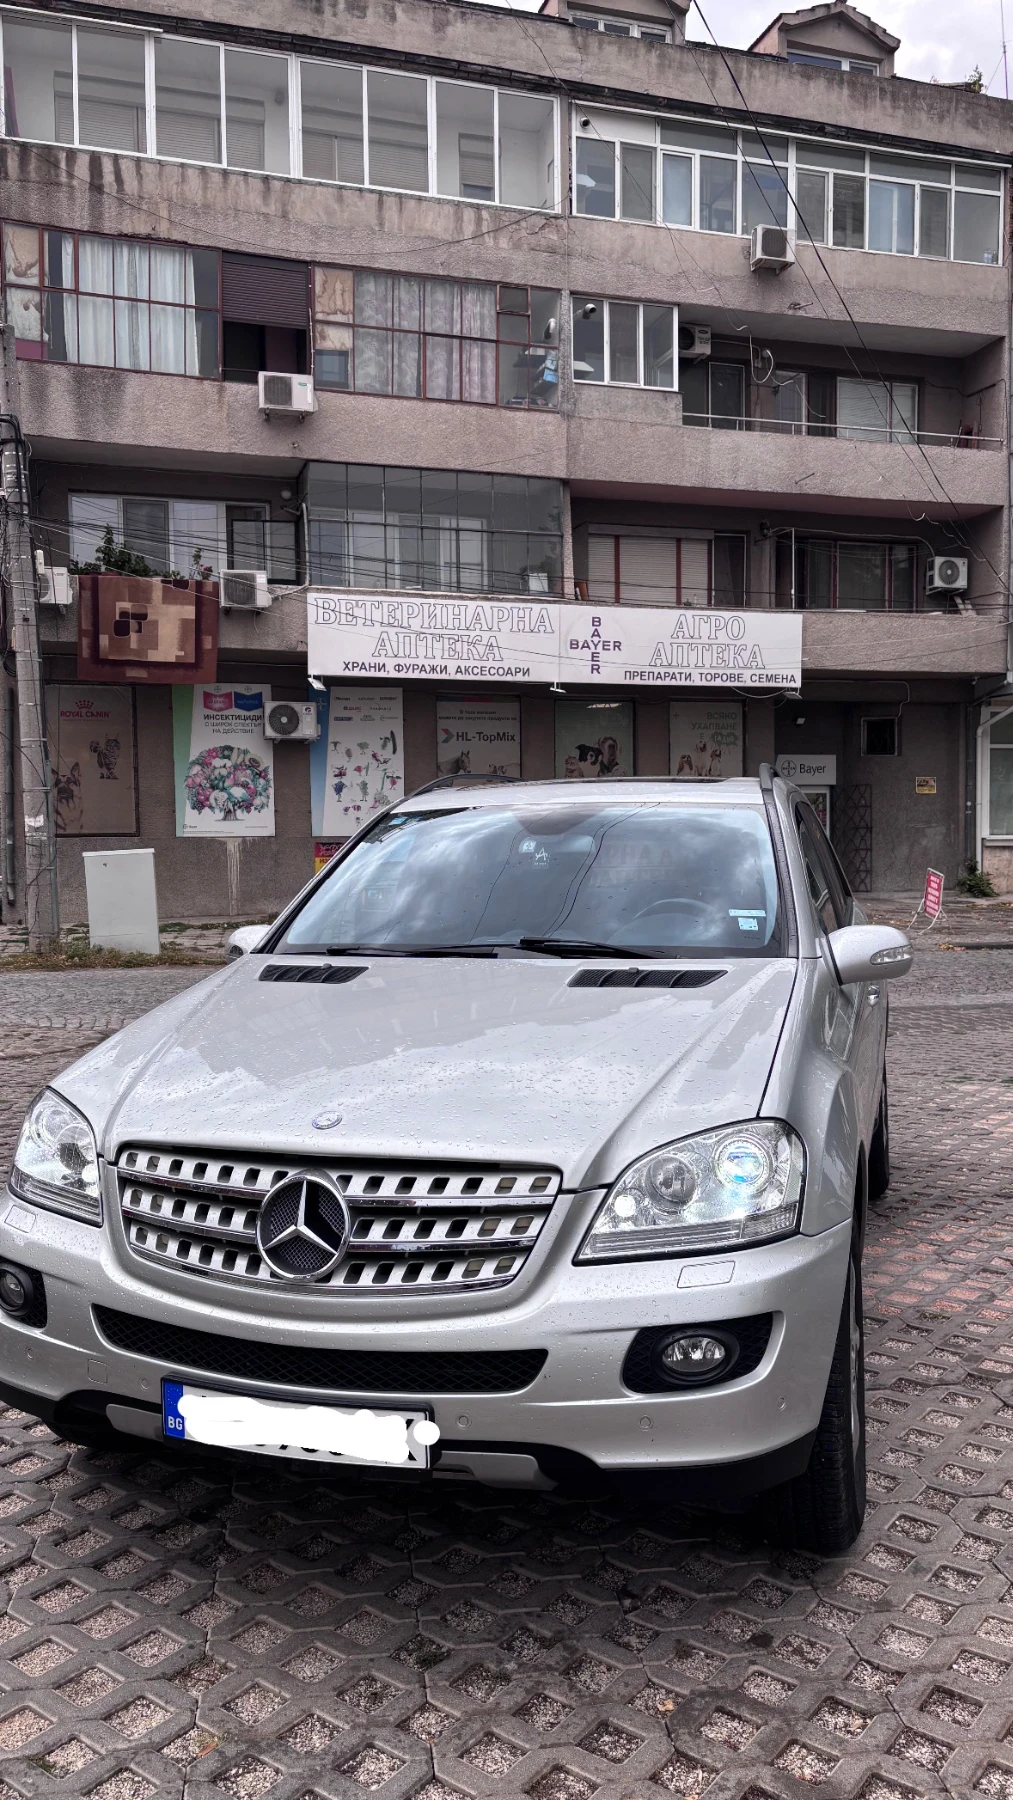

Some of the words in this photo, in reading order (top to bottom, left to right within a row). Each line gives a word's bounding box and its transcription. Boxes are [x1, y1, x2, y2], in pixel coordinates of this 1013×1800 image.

[315, 598, 554, 633] ВЕТЕРИНАРНА
[671, 614, 746, 640] АГРО
[372, 631, 503, 661] АПТЕКА
[569, 639, 622, 651] BAYER
[590, 616, 602, 675] BAYER
[650, 641, 765, 669] АПТЕКА
[343, 661, 390, 675] ХРАНИ,
[394, 663, 451, 676] ФУРАЖИ,
[455, 665, 530, 677] АКСЕСОАРИ
[624, 670, 695, 683] ПРЕПАРАТИ,
[698, 672, 746, 684] ТОРОВЕ,
[750, 673, 797, 684] СЕМЕНА
[60, 710, 84, 718] ROYAL
[85, 710, 110, 718] CANIN
[203, 714, 263, 722] ИНСЕКТИЦИДИ
[706, 711, 738, 720] ВСЯКО
[691, 722, 738, 730] УХАПВАНЕ
[456, 731, 516, 744] HL-TopMix
[799, 763, 827, 777] Bayer
[167, 1415, 183, 1431] BG
